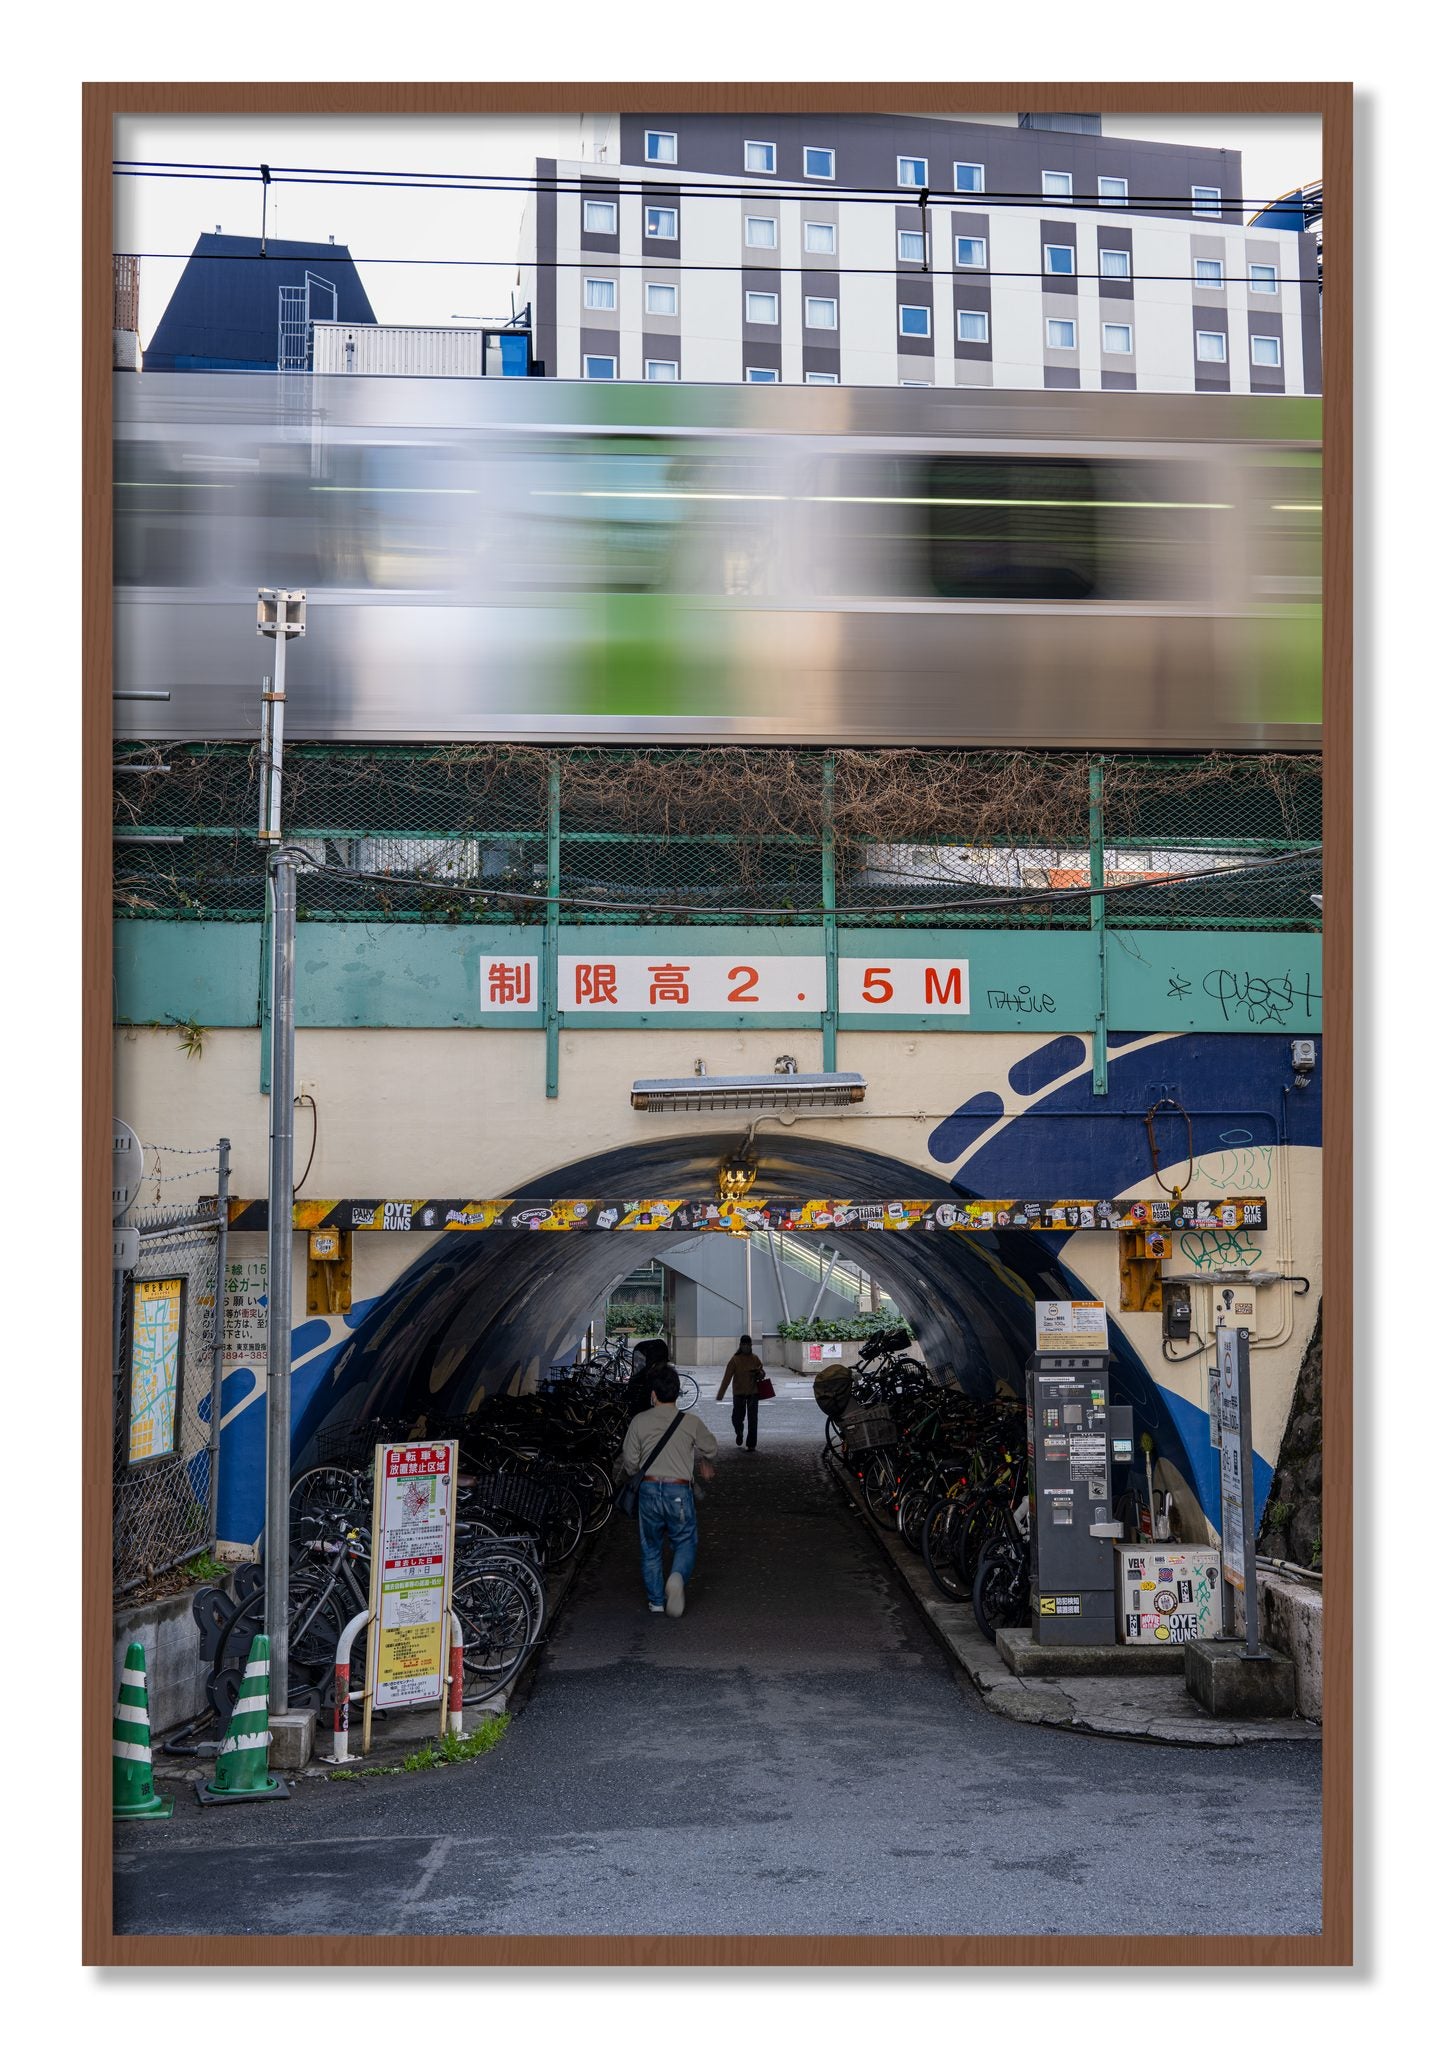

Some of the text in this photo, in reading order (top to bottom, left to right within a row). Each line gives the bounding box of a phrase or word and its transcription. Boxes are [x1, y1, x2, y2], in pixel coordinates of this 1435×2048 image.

[384, 1202, 412, 1217] OYE
[1243, 1206, 1261, 1214] OYE
[383, 1216, 411, 1230] RUNS
[1244, 1213, 1262, 1223] RUNS
[390, 1461, 446, 1475] 放置禁止区域
[1169, 1614, 1197, 1628] OYE
[1170, 1628, 1197, 1643] RUNS
